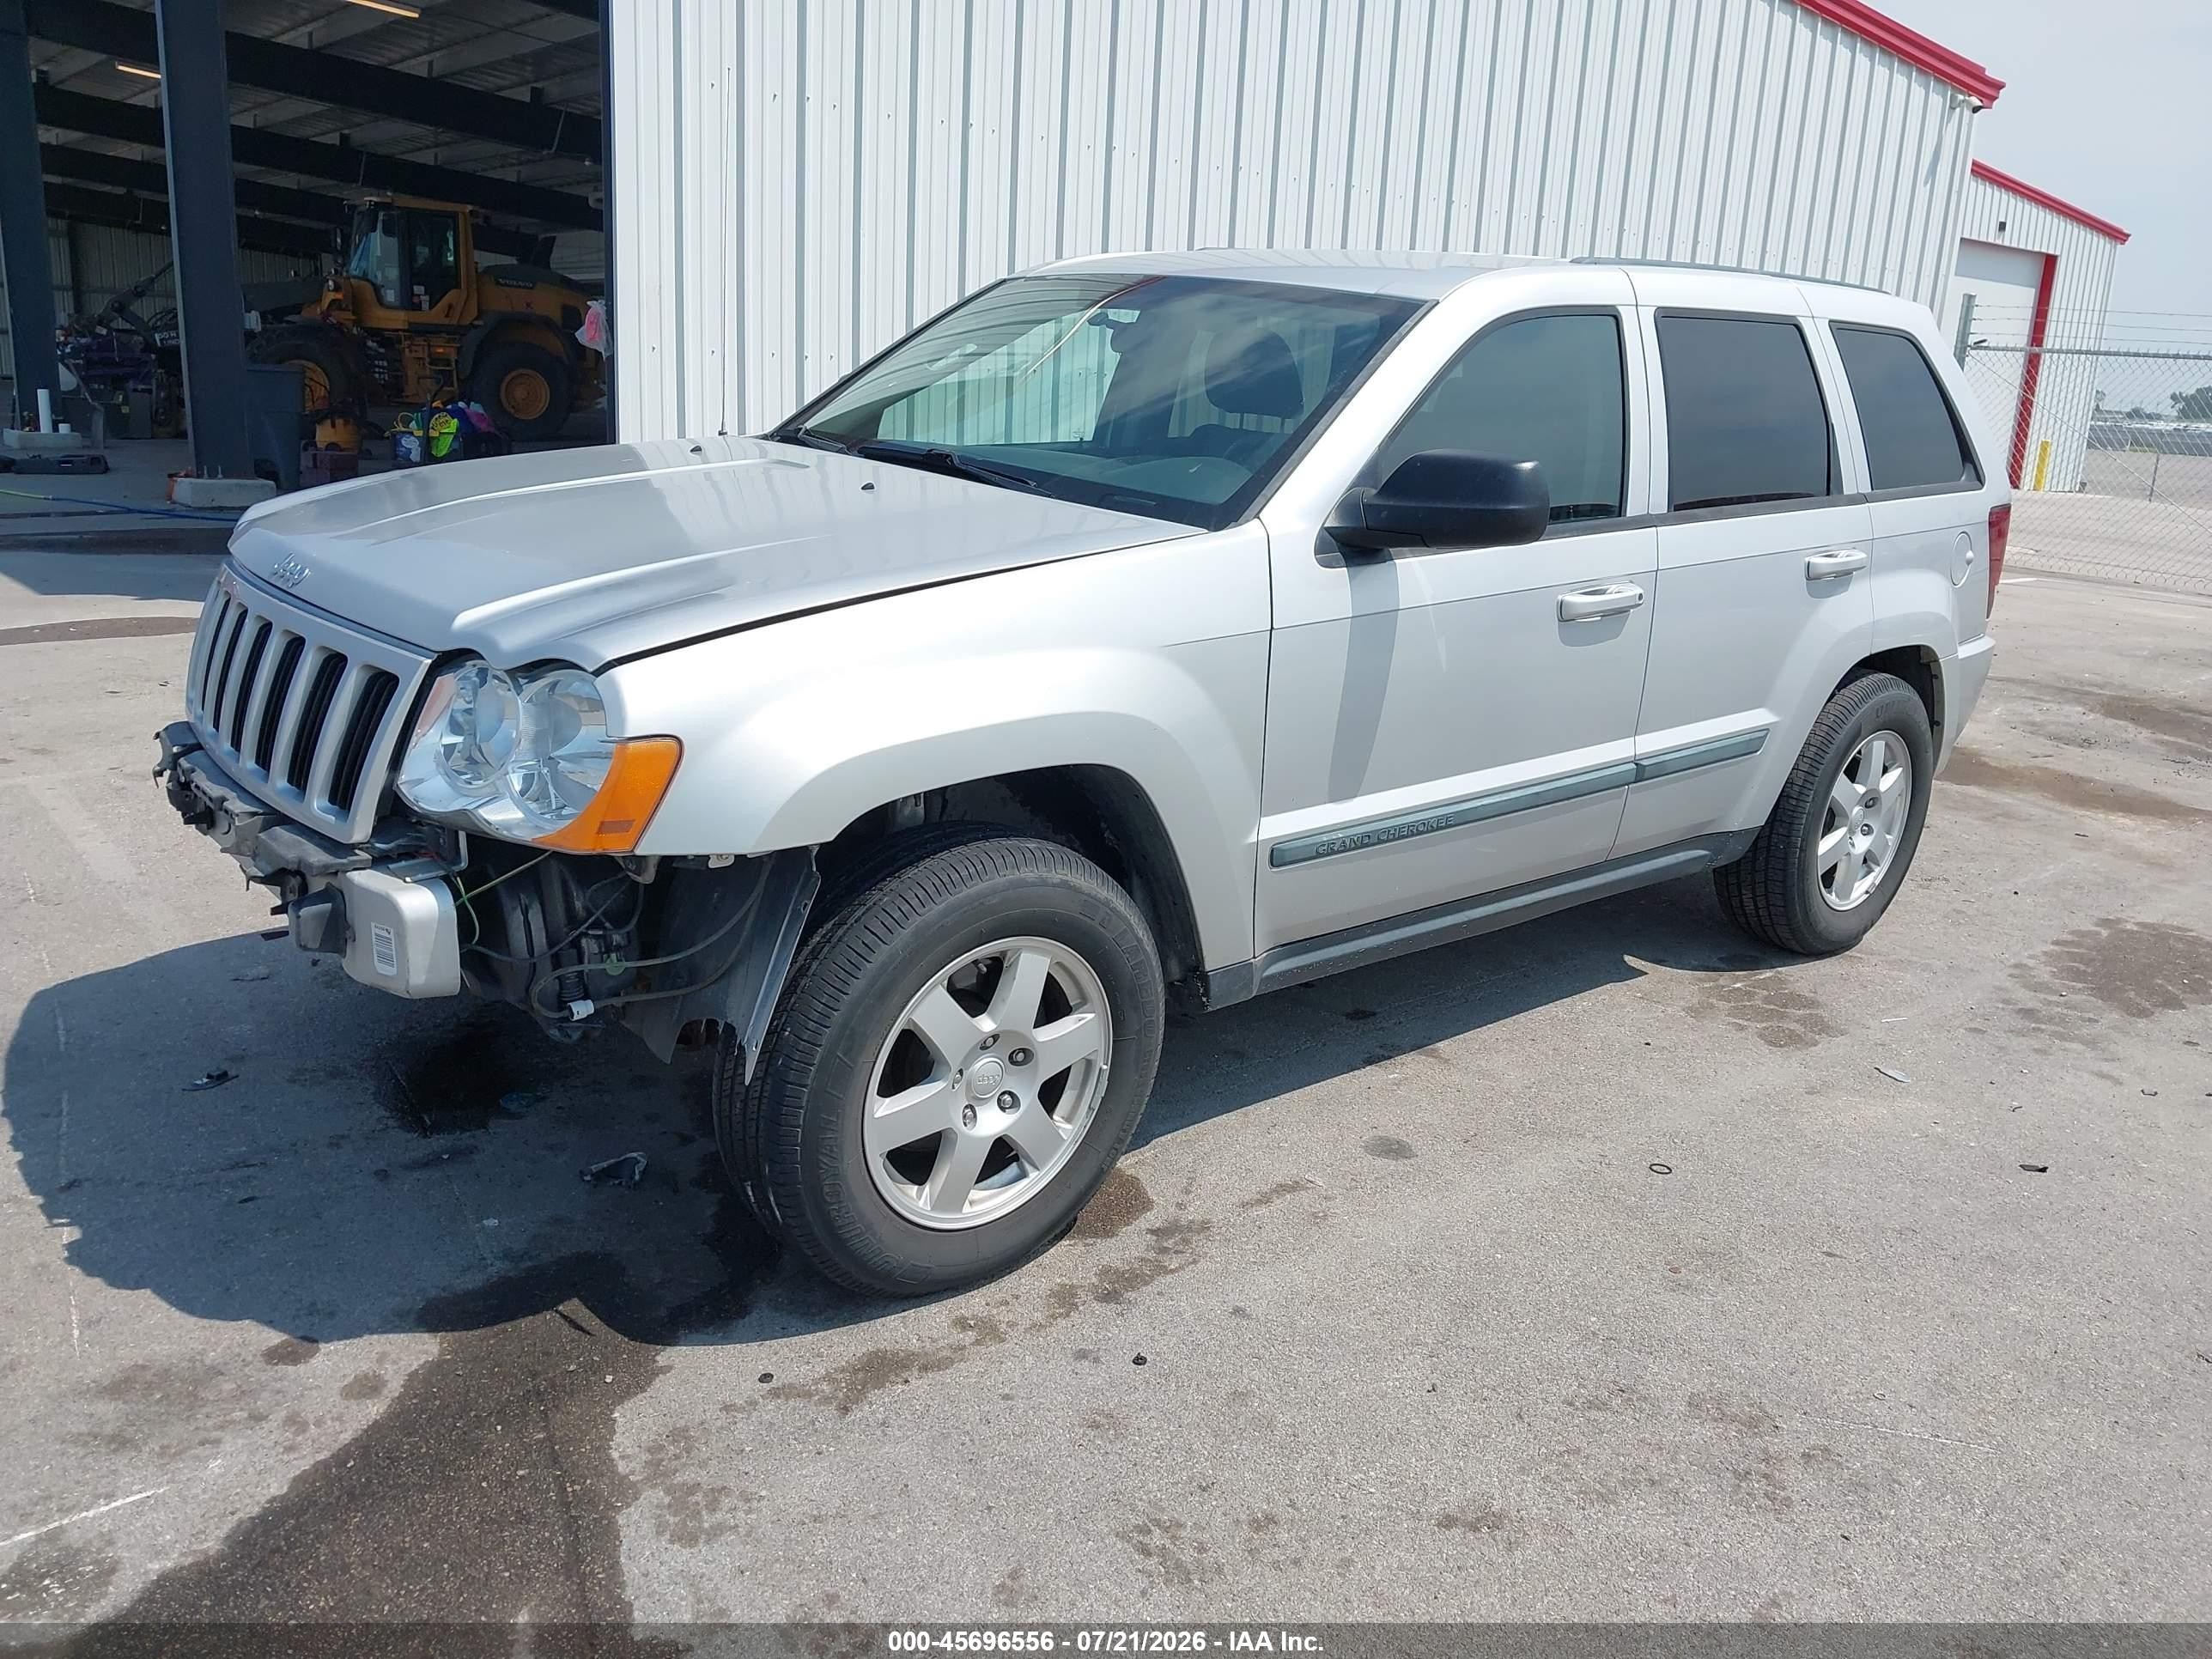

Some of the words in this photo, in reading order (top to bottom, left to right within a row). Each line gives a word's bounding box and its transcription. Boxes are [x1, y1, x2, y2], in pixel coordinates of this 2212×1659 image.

[272, 551, 311, 589] Jeep
[1315, 833, 1371, 855] GRAND
[1376, 815, 1455, 842] CHEROKEE
[817, 1109, 901, 1273] UNIROYAL
